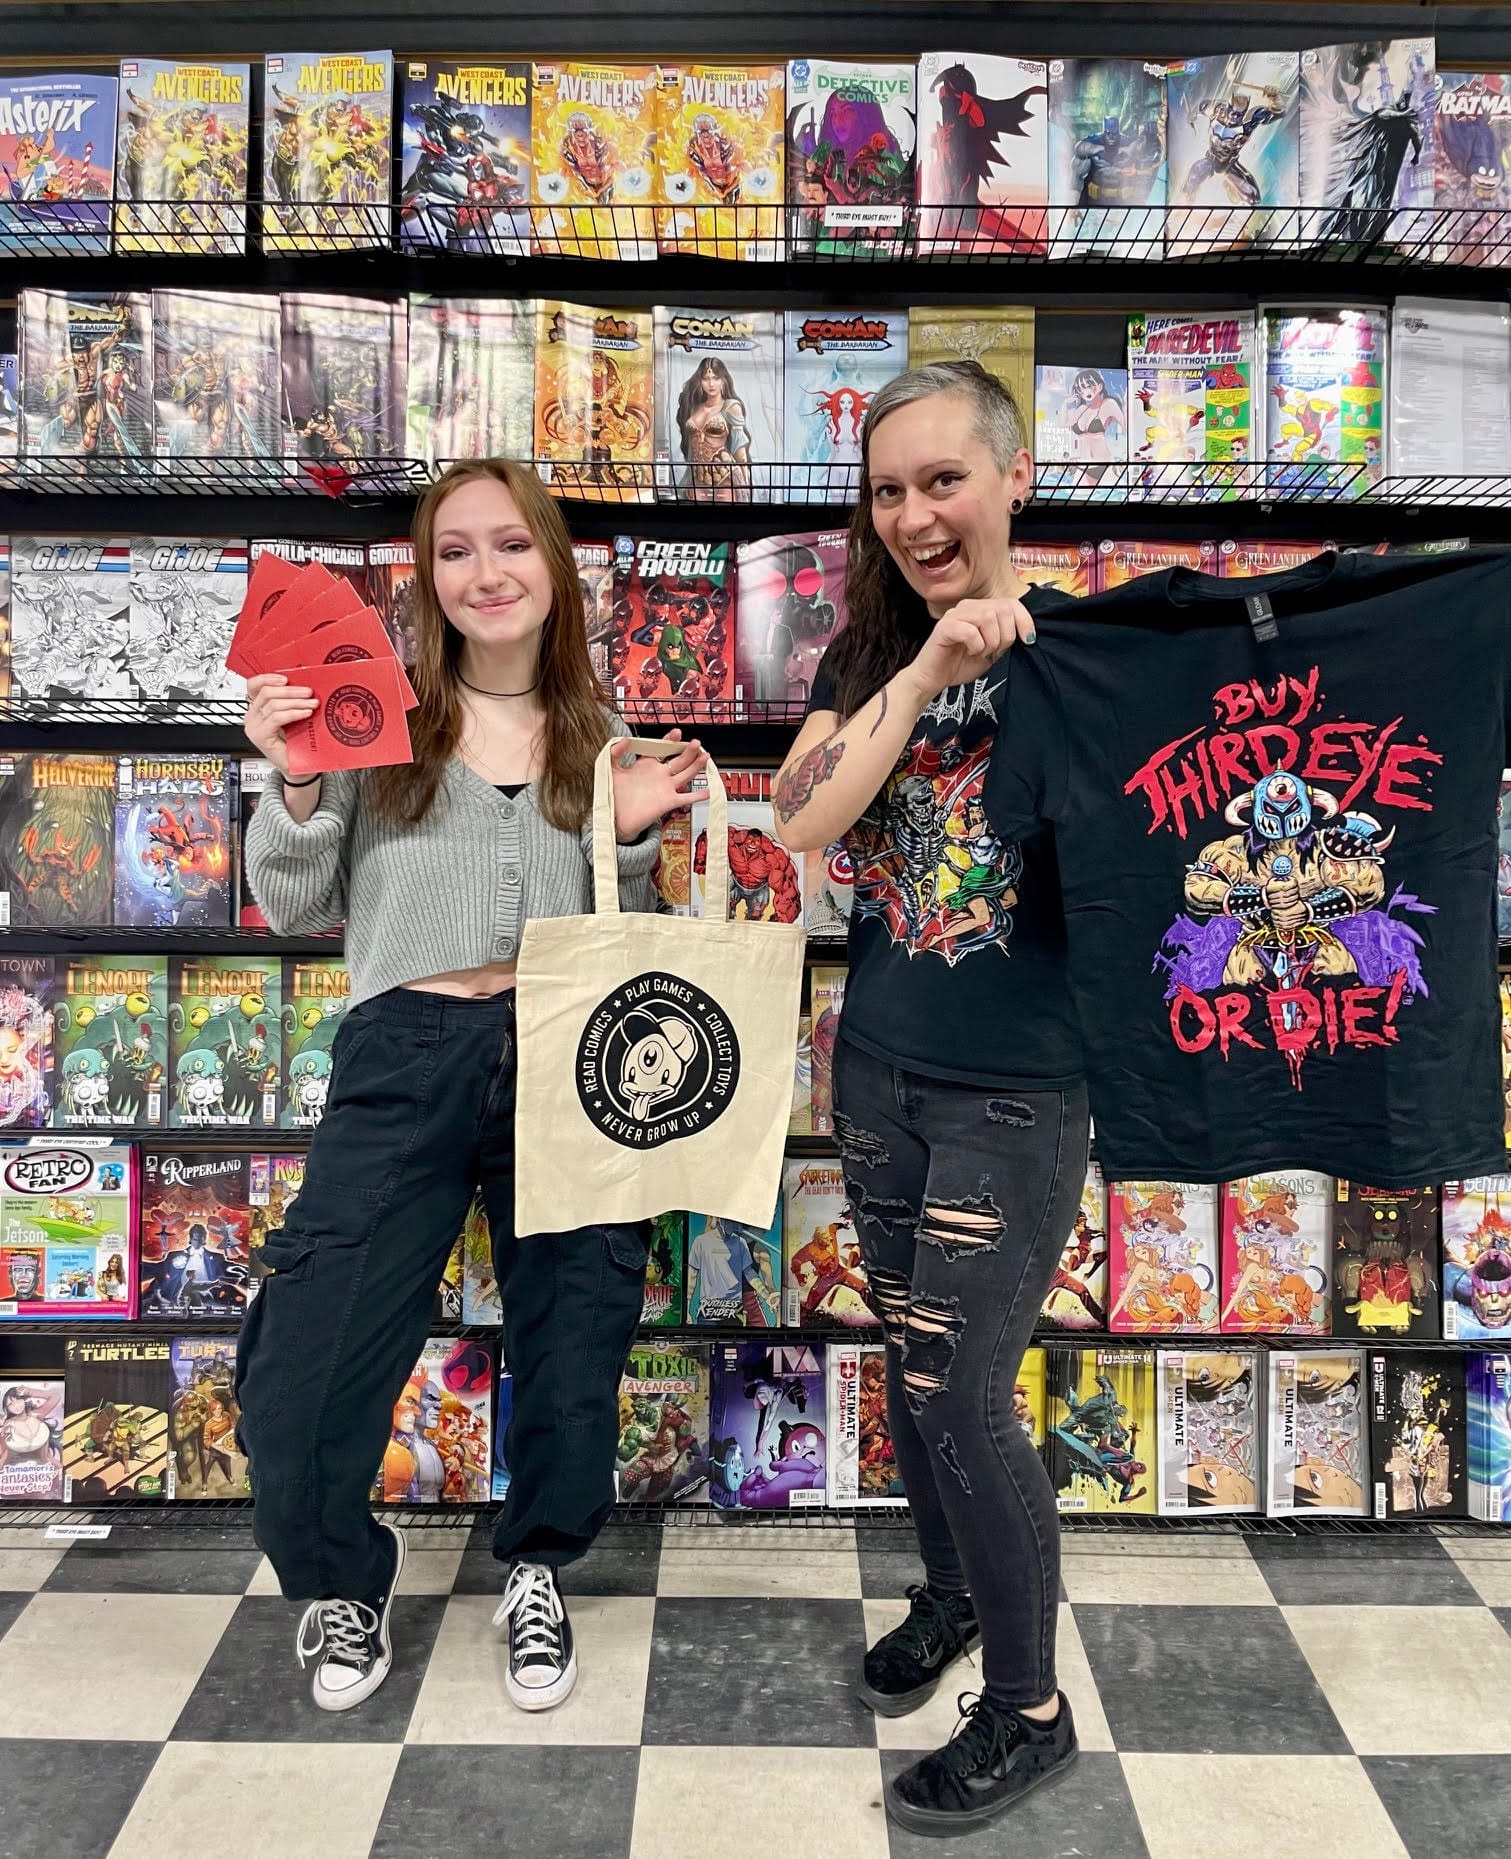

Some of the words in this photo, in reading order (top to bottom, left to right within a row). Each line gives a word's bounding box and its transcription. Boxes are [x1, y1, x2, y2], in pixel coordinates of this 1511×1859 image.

[178, 67, 198, 77] WEST
[199, 68, 219, 78] COAST
[321, 58, 342, 67] WEST
[342, 58, 363, 67] COAST
[298, 63, 385, 95] AVENGERS
[460, 70, 479, 80] WEST
[480, 70, 504, 80] COAST
[581, 70, 600, 81] WEST
[600, 71, 623, 82] COAST
[704, 71, 723, 82] WEST
[723, 72, 746, 82] COAST
[817, 75, 909, 94] DETECTIVE
[153, 74, 243, 104] AVENGERS
[437, 73, 527, 106] AVENGERS
[558, 73, 644, 107] AVENGERS
[682, 74, 769, 107] AVENGERS
[837, 92, 889, 104] COMICS
[1439, 92, 1511, 115] BATMA
[672, 317, 753, 338] CONAN
[803, 317, 886, 340] CONAN
[1144, 320, 1243, 355] DAREDEVIL
[1145, 319, 1170, 336] HERE
[708, 340, 747, 349] BARBARIAN
[826, 340, 846, 349] THE
[847, 340, 878, 350] BARBARIAN
[1131, 357, 1148, 365] THE
[1172, 356, 1212, 365] WITHOUT
[1215, 354, 1244, 363] FEAR!
[310, 547, 365, 567] CHICAGO
[369, 547, 416, 566] GODZILL
[636, 540, 711, 559] GREEN
[1031, 552, 1072, 568] LANTERN
[638, 557, 725, 578] ARROW
[1113, 552, 1148, 569] GREEN
[1150, 552, 1192, 568] LANTERN
[1234, 552, 1270, 569] GREEN
[1213, 665, 1322, 726] BUY
[31, 757, 117, 789] HELLVERINE
[134, 758, 225, 781] HORNSBY
[1123, 723, 1303, 840] THIRD
[1301, 716, 1444, 812] EYE
[134, 779, 225, 796] HALO
[1, 959, 46, 973] TOWN
[66, 969, 153, 997] LENORE
[180, 969, 268, 997] LENORE
[293, 969, 351, 998] LENO
[624, 979, 651, 1002] PLAY
[653, 978, 694, 1004] GAMES
[1167, 981, 1268, 1062] OR
[1264, 966, 1410, 1068] DIE!
[584, 1010, 613, 1057] COMICS
[704, 1012, 733, 1063] COLLECT
[582, 1060, 599, 1094] READ
[712, 1066, 733, 1097] TOYS
[64, 1114, 85, 1125] THE
[86, 1114, 112, 1125] TIME
[112, 1114, 136, 1125] WAR
[179, 1114, 200, 1125] THE
[201, 1114, 226, 1125] TIME
[601, 1111, 643, 1142] NEVER
[647, 1118, 680, 1142] GROW
[683, 1110, 702, 1128] UP
[15, 1157, 86, 1180] RETRO
[161, 1157, 242, 1187] RIPPERLAND
[29, 1176, 67, 1188] FAN
[1249, 1175, 1315, 1195] SEASONS
[9, 1218, 20, 1227] The
[80, 1346, 171, 1361] TURTLES
[179, 1345, 237, 1359] TURTL
[629, 1351, 698, 1380] TOXIC
[624, 1380, 694, 1393] AVENGER
[847, 1380, 857, 1439] ULTIMATE
[1174, 1386, 1184, 1446] ULTIMATE
[1284, 1388, 1294, 1447] ULTIMATE
[0, 1473, 51, 1485] antasies
[0, 1484, 24, 1493] ever
[26, 1482, 53, 1492] Stop!
